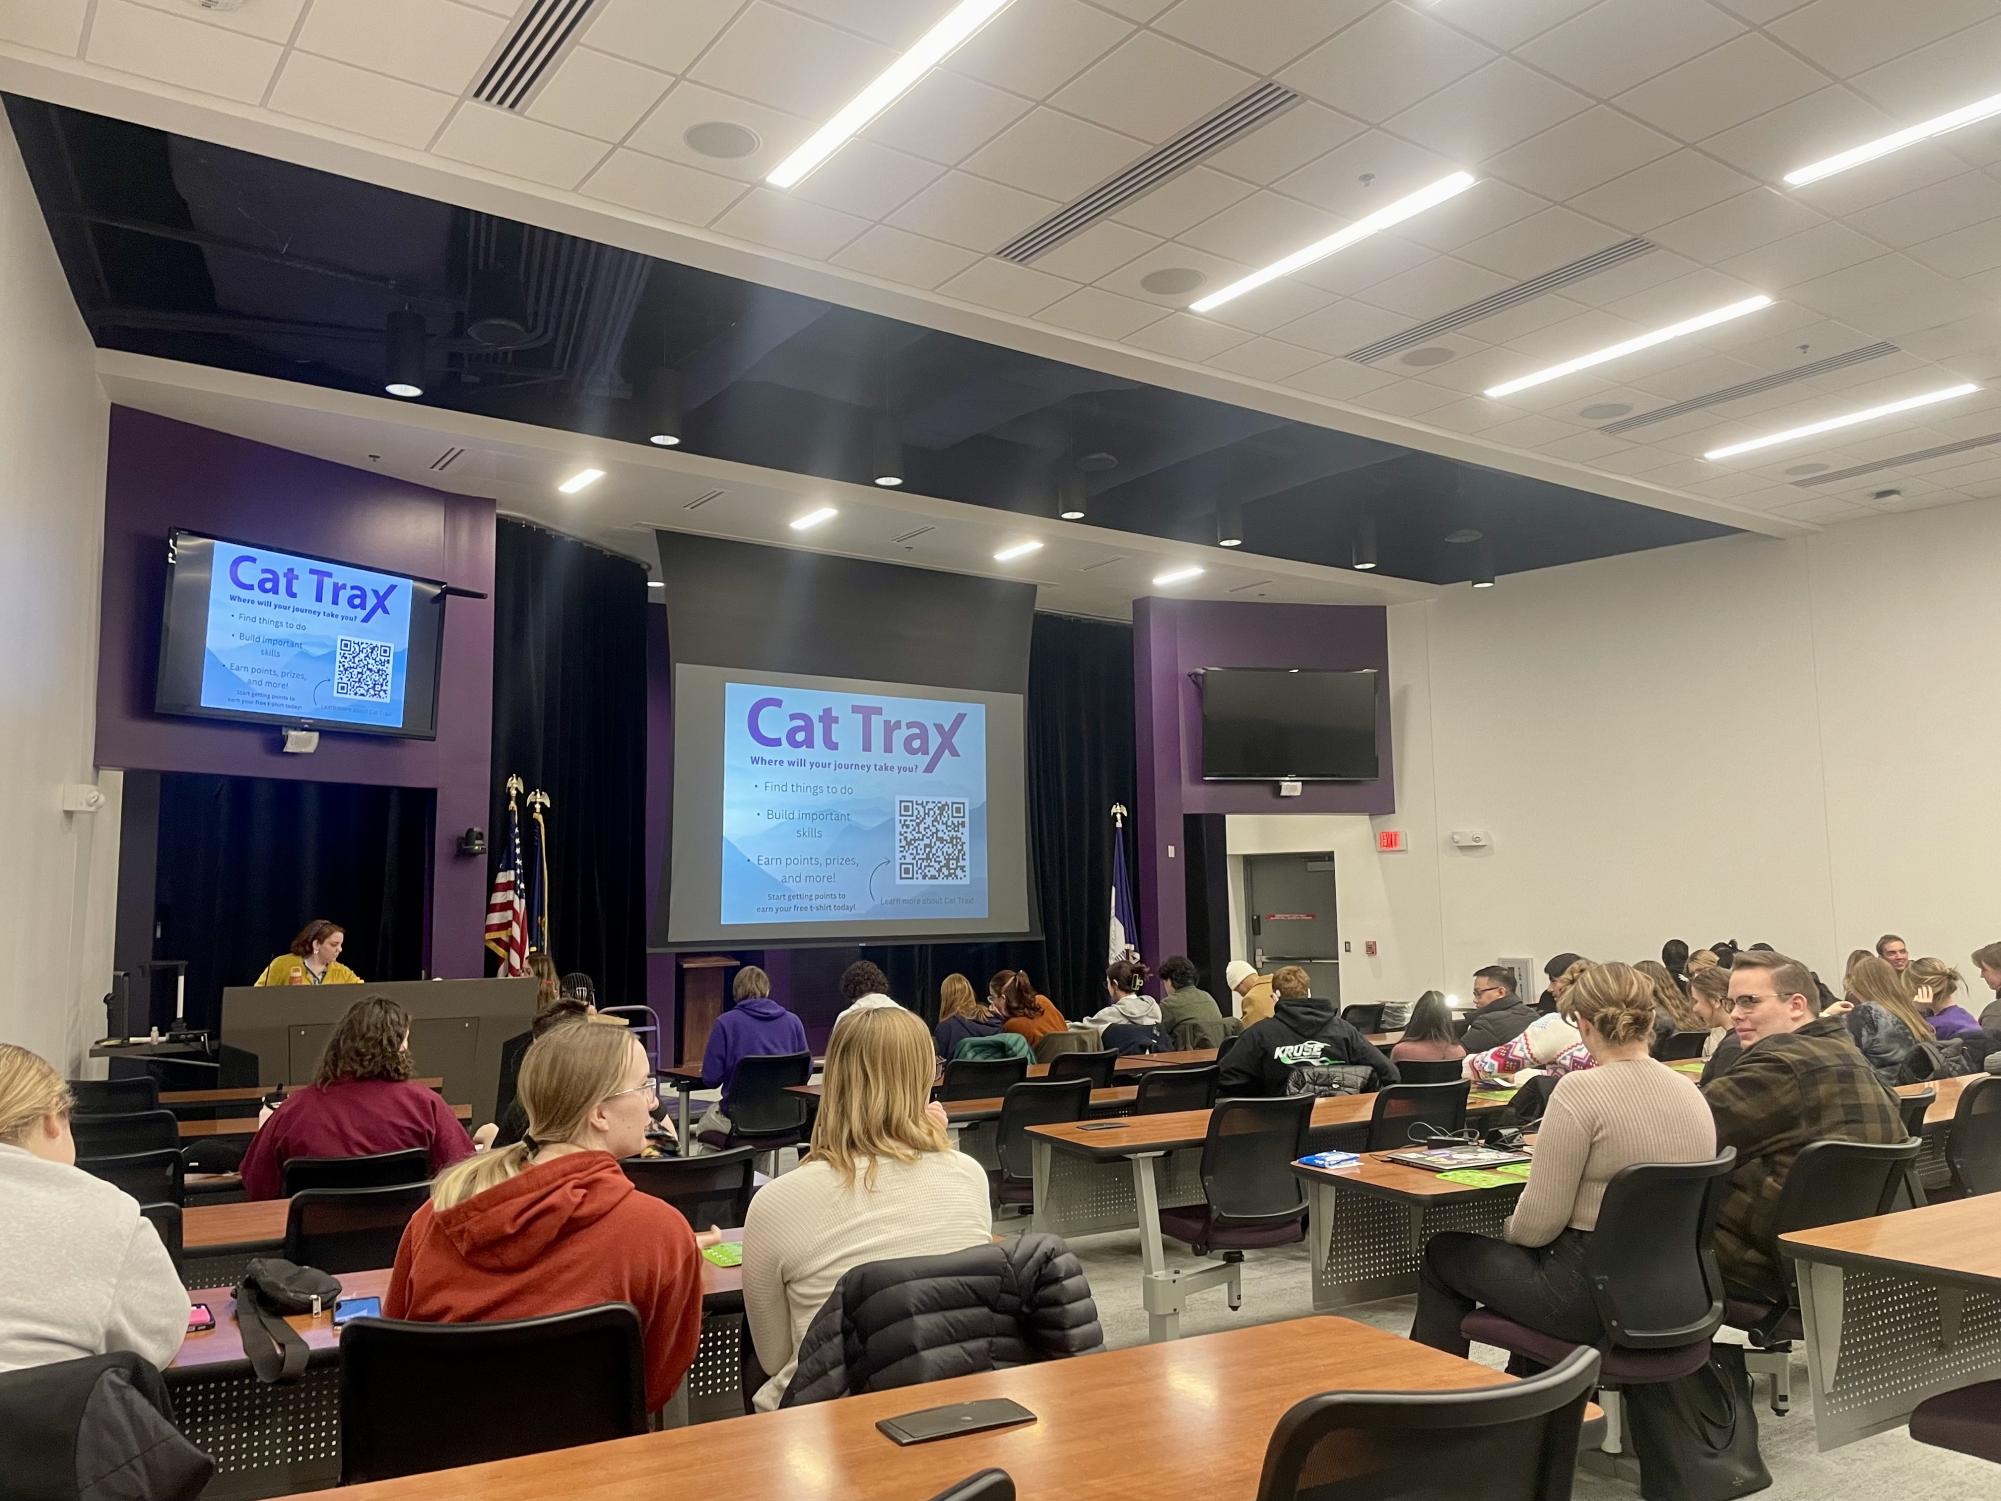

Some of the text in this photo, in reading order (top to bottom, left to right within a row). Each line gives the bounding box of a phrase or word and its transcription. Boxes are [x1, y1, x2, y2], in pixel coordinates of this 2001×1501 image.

[229, 554, 299, 599] Cat
[229, 594, 358, 622] Where will your journey take you?
[239, 613, 307, 631] Find things to do
[239, 632, 303, 649] Build important
[260, 648, 280, 658] skills
[229, 662, 307, 681] Earn points, prizes,
[247, 678, 289, 689] and more!
[747, 697, 840, 751] Cat
[750, 755, 918, 774] Where will your journey take you?
[764, 781, 854, 796] Find things to do
[766, 809, 851, 823] Build important
[796, 827, 823, 839] skills
[1380, 831, 1399, 848] EXIT
[757, 854, 859, 868] Earn points, prizes,
[781, 872, 836, 883] and more!
[767, 892, 846, 903] Start getting points to
[880, 897, 900, 905] Learn
[922, 897, 943, 905] about
[774, 906, 792, 914] your
[793, 904, 808, 912] free
[809, 903, 832, 912] t-shirt
[833, 903, 856, 913] today!
[1273, 1042, 1326, 1060] KRUSE
